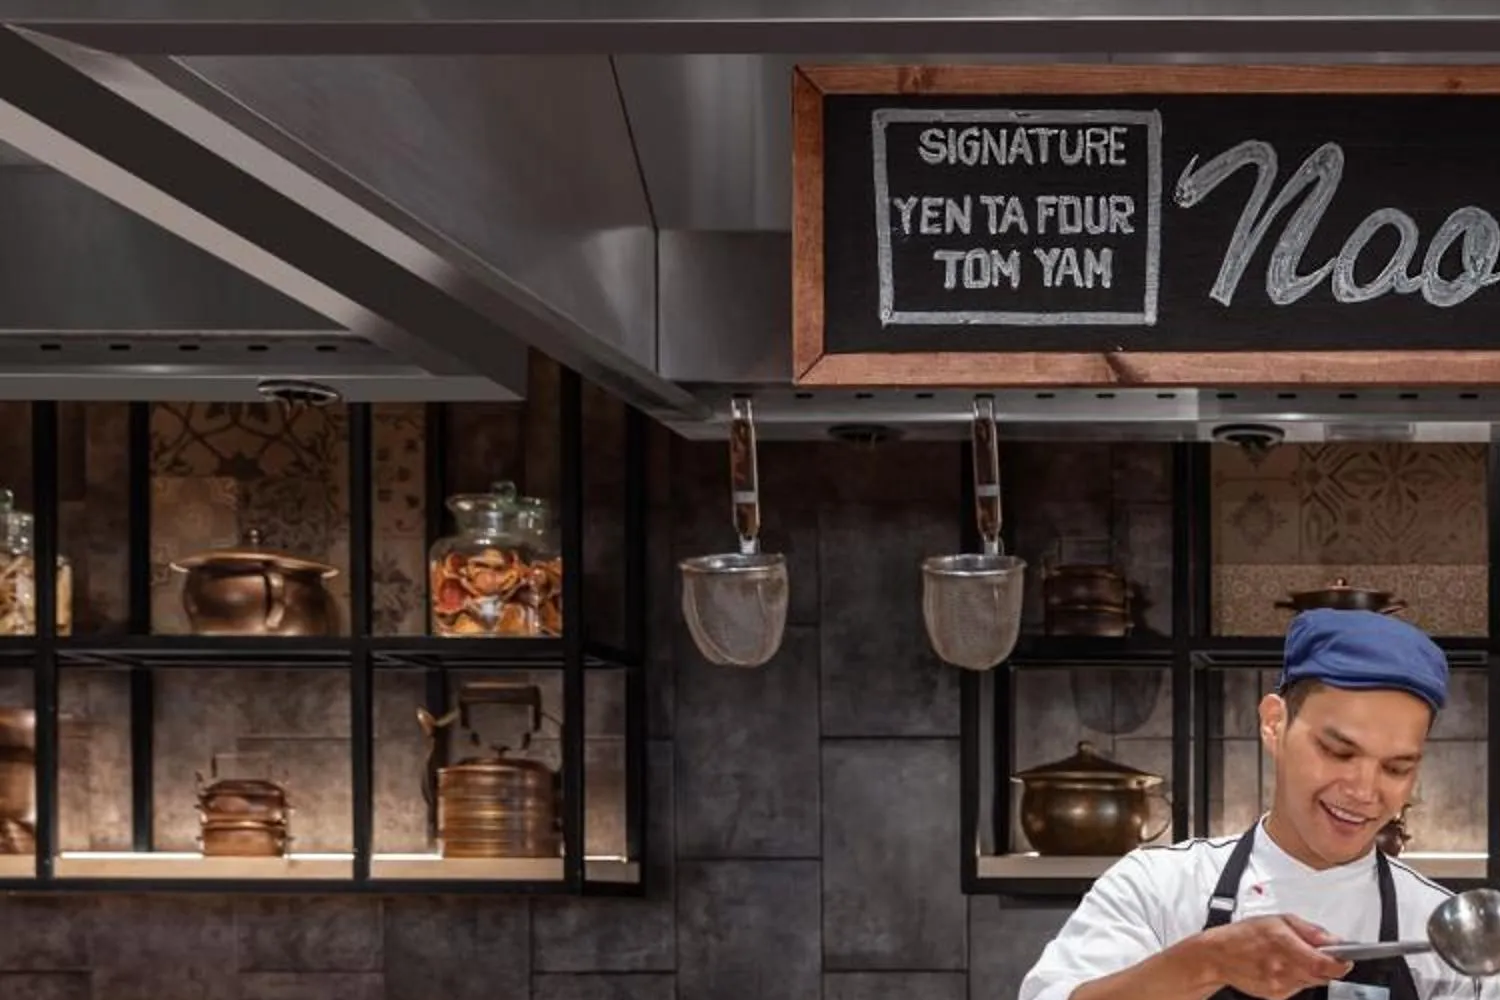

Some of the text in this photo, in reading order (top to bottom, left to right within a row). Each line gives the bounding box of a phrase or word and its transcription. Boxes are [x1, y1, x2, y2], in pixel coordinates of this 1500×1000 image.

[918, 126, 1128, 166] SIGNATURE
[893, 194, 1136, 235] YEN TA FOUR
[932, 247, 1114, 289] TOM YAM
